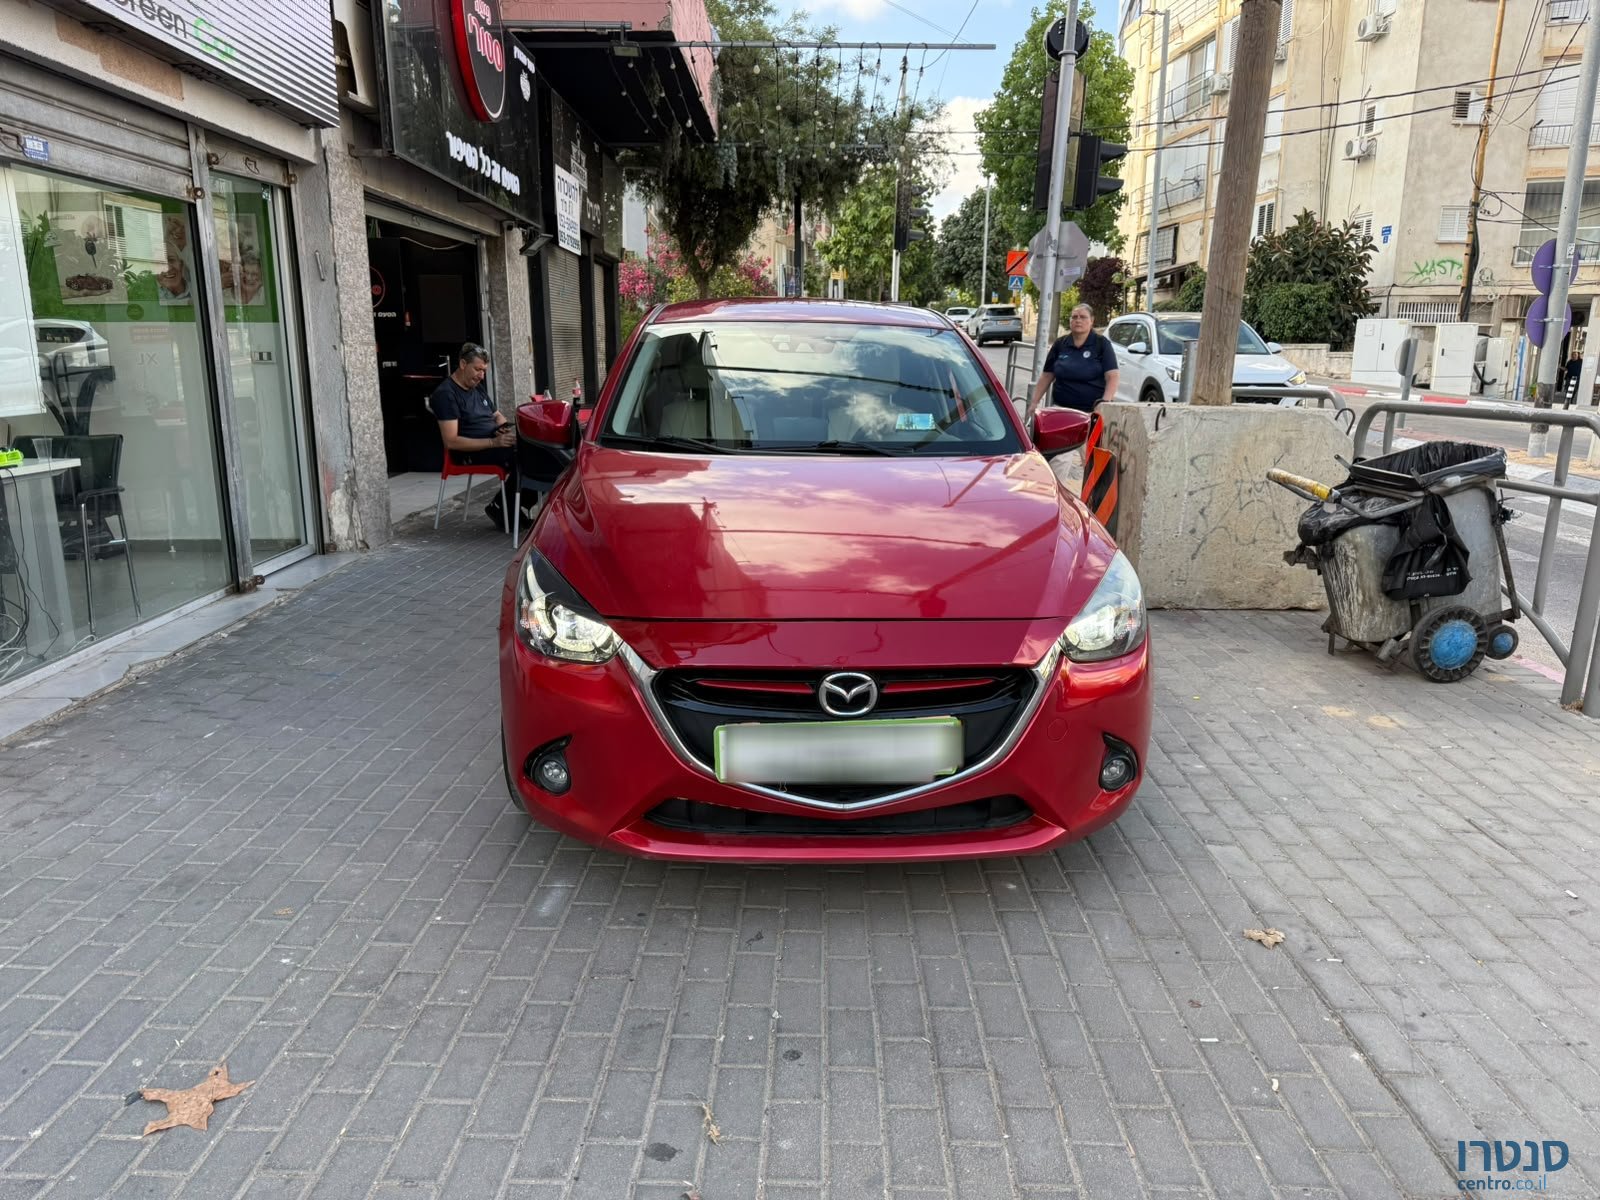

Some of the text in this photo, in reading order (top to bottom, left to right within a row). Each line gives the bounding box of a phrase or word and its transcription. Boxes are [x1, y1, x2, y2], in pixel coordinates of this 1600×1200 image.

[445, 130, 478, 171] הסיפור
[479, 146, 492, 178] כל
[501, 166, 520, 196] הטעם
[557, 174, 579, 204] להשכרה
